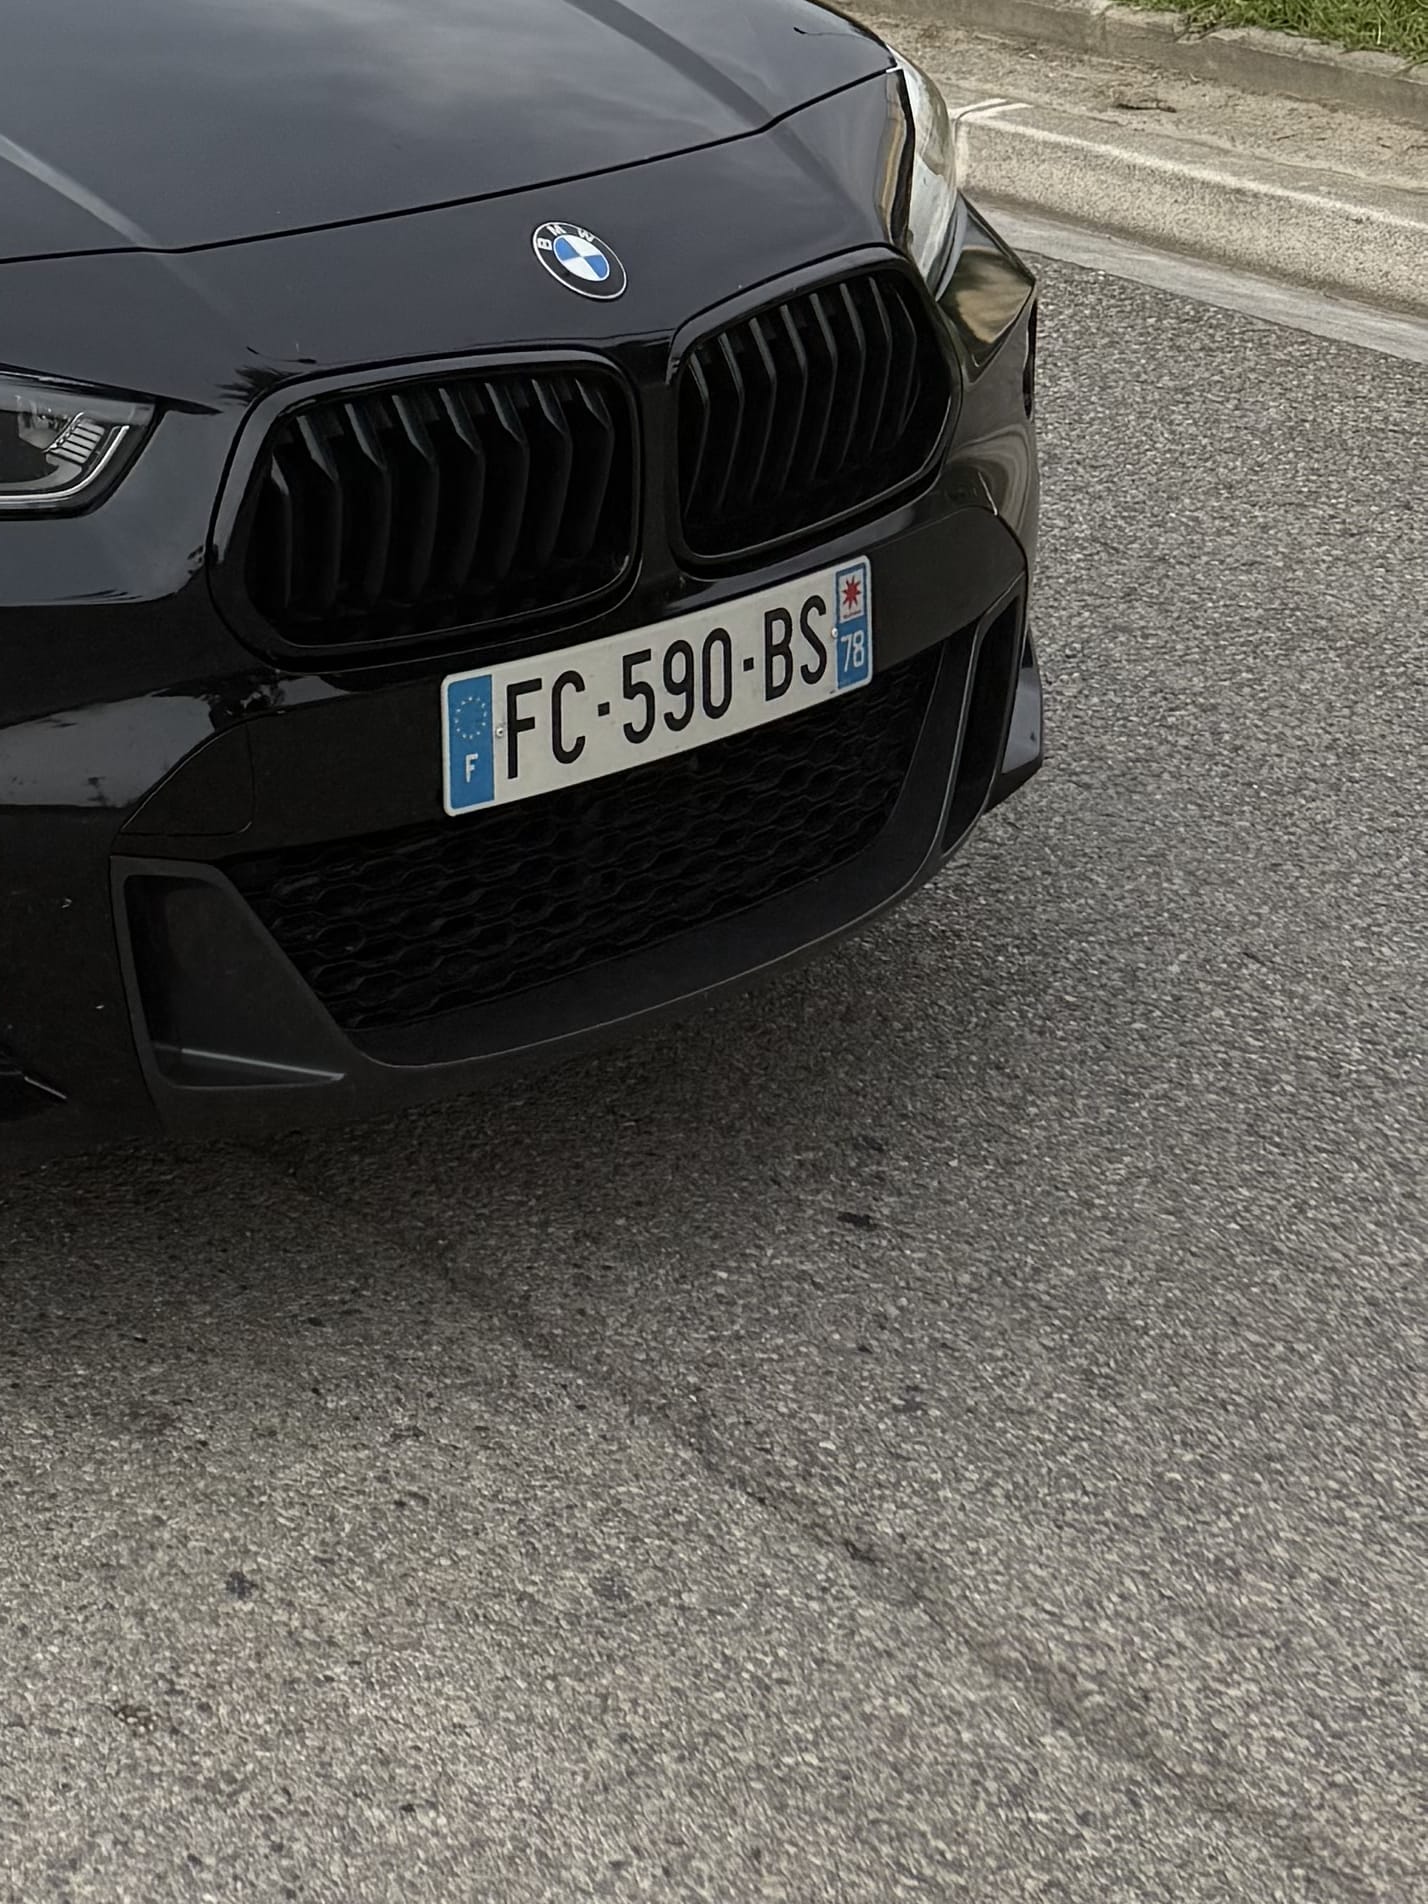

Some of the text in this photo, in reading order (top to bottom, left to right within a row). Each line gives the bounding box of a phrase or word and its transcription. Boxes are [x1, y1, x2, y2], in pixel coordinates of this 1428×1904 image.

[536, 223, 596, 251] BMW
[840, 629, 866, 674] 78
[506, 595, 828, 780] FC-590-BS
[465, 752, 479, 784] F
